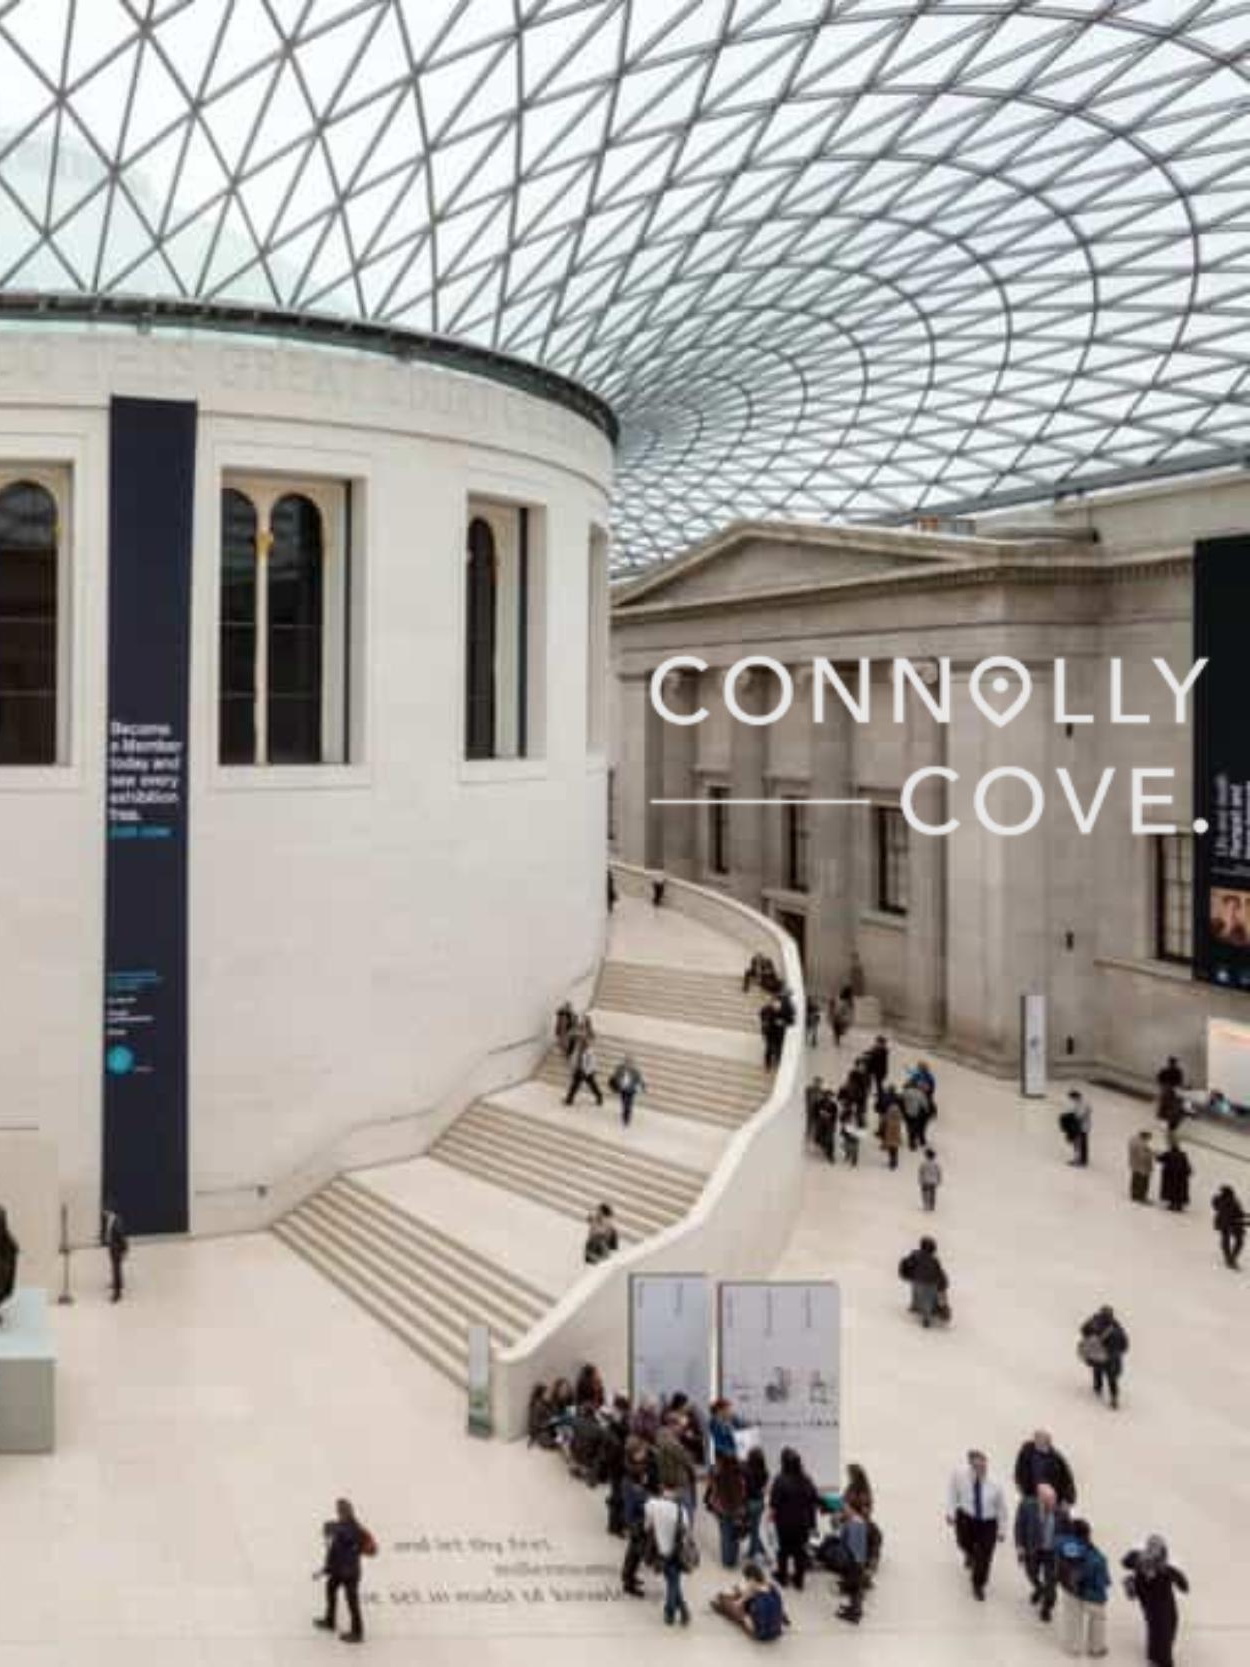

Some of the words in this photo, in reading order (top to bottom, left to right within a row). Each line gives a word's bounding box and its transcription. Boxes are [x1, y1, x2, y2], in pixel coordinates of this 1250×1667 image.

[111, 757, 149, 771] today
[153, 756, 179, 770] and
[139, 776, 177, 789] every
[111, 791, 179, 804] exhibition
